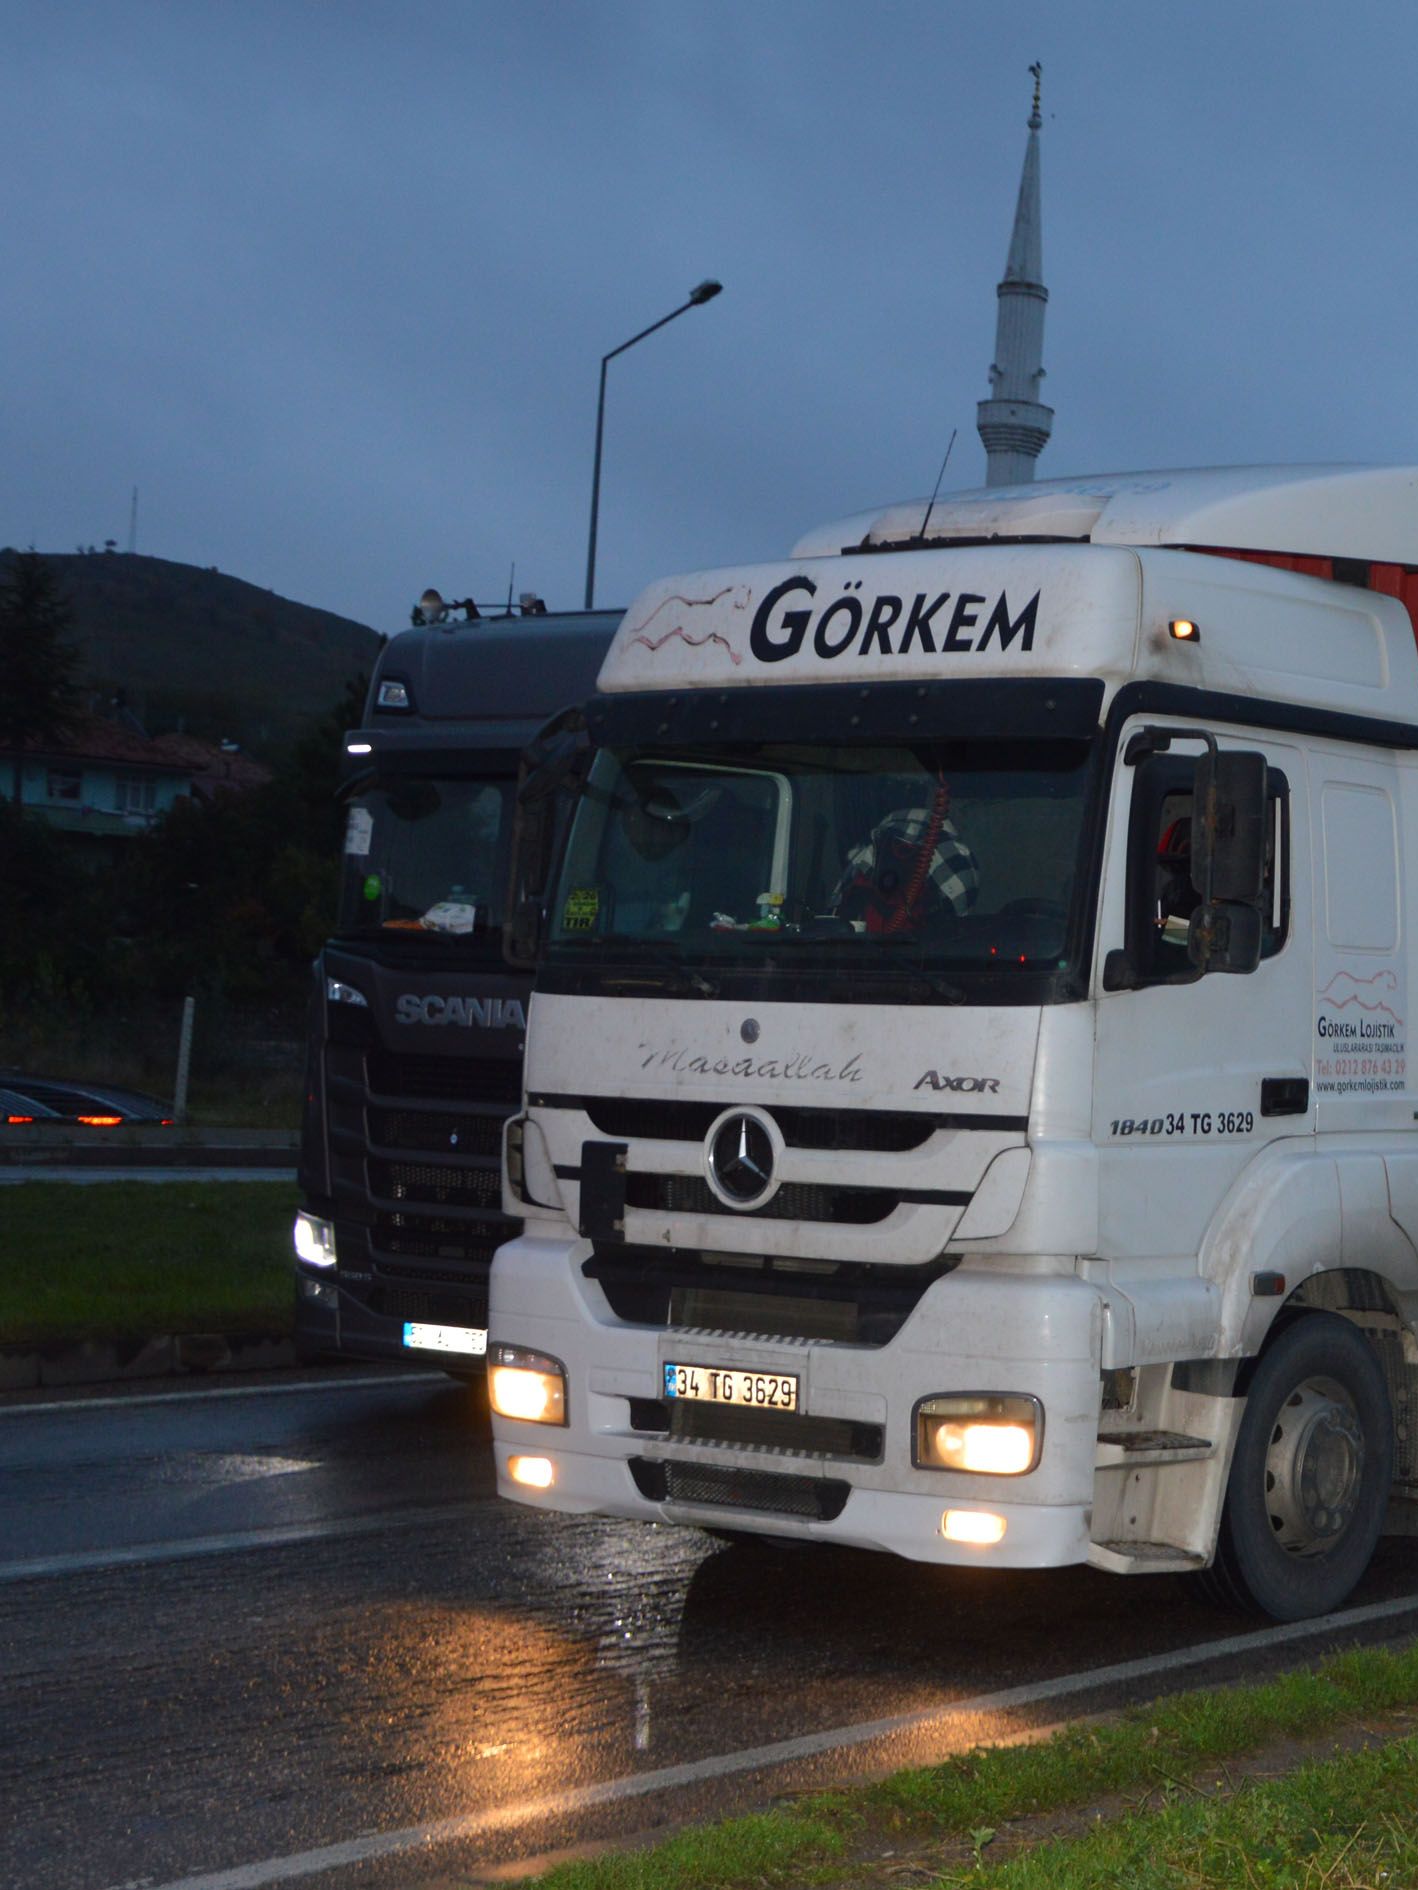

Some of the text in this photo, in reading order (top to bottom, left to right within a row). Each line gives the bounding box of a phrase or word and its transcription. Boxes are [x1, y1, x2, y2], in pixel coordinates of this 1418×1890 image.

[749, 575, 1042, 664] GÖRKEM
[394, 993, 526, 1030] SCANIA
[1317, 1015, 1357, 1038] GÖRKEM
[1316, 1058, 1406, 1075] Tel: 0212 876 43 29
[1316, 1078, 1405, 1096] www.gorkemlojistik.com
[1110, 1118, 1164, 1136] 1840
[1165, 1111, 1254, 1135] 34 TG 3629
[677, 1369, 700, 1397] 34
[711, 1372, 733, 1401] TG
[743, 1376, 792, 1407] 3629
